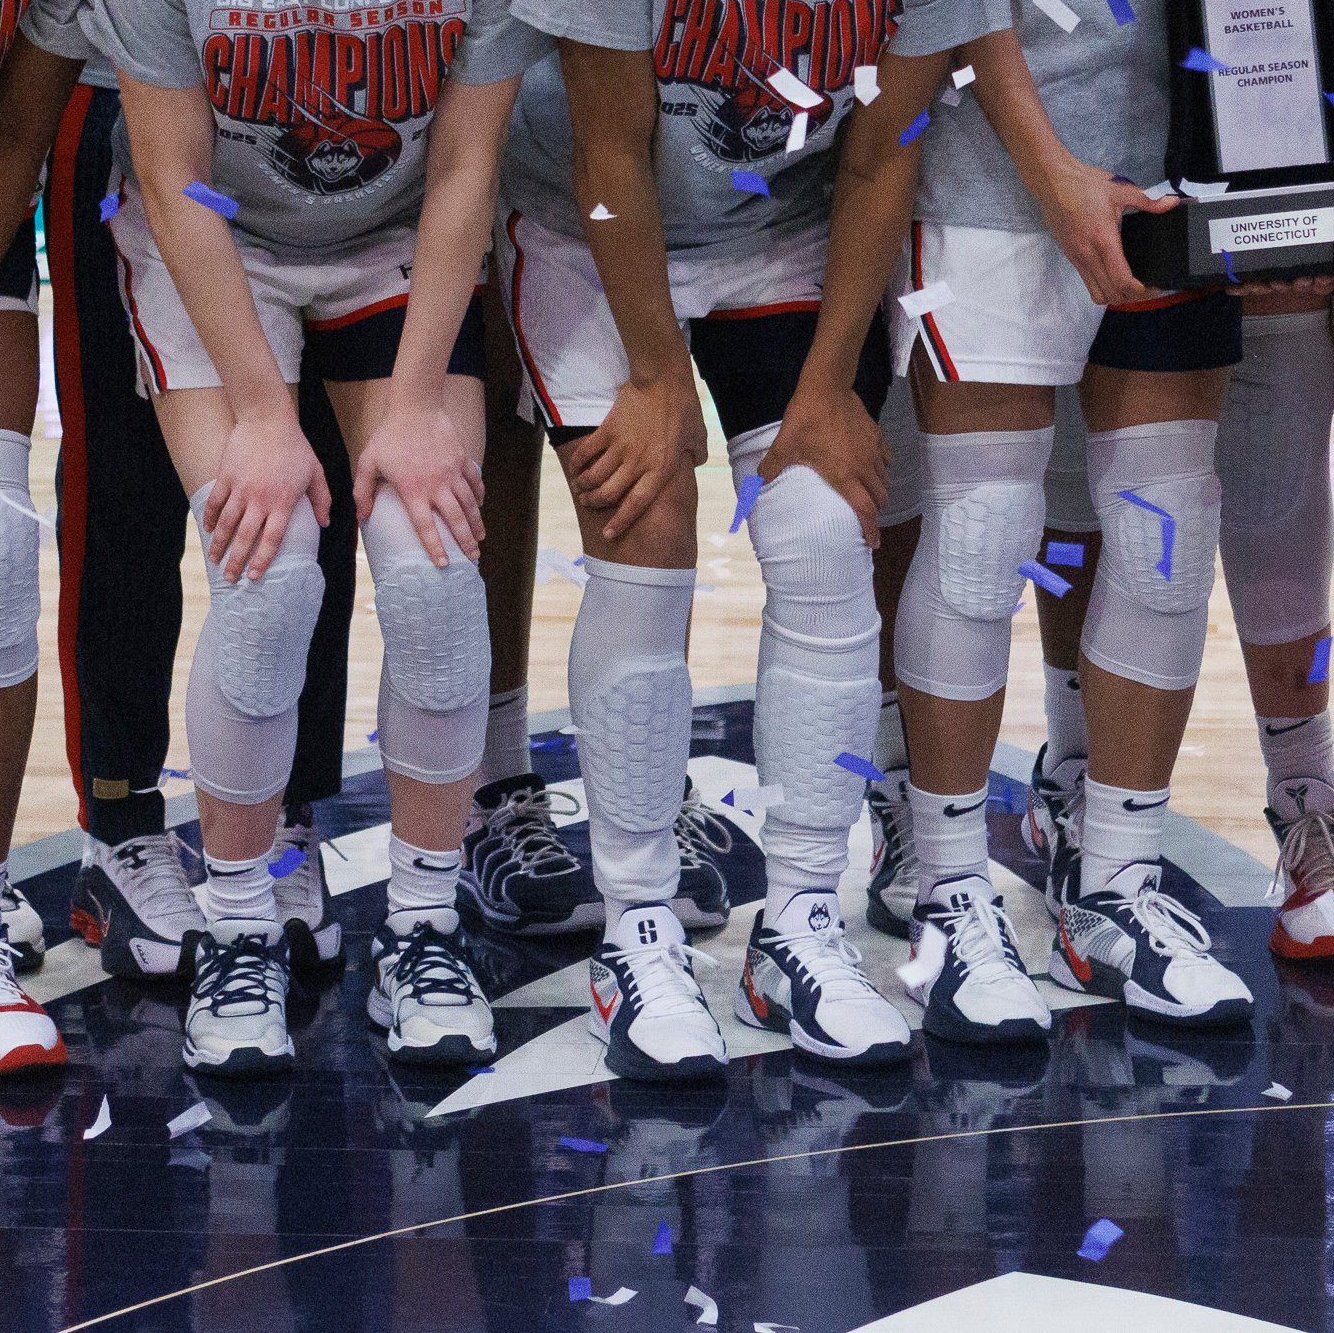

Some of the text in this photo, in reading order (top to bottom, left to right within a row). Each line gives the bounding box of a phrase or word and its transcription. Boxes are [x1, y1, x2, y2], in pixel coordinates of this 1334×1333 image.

[228, 10, 335, 30] REGULAR
[1230, 6, 1285, 20] WOMEN'S
[1224, 19, 1294, 35] BASKETBALL
[1218, 60, 1309, 77] REGULAR SEASON
[1237, 74, 1293, 88] CHAMPION
[661, 101, 699, 117] 025
[219, 129, 258, 146] 025
[1230, 215, 1318, 233] UNIVERSITY OF
[1234, 228, 1318, 245] CONNECTICUT
